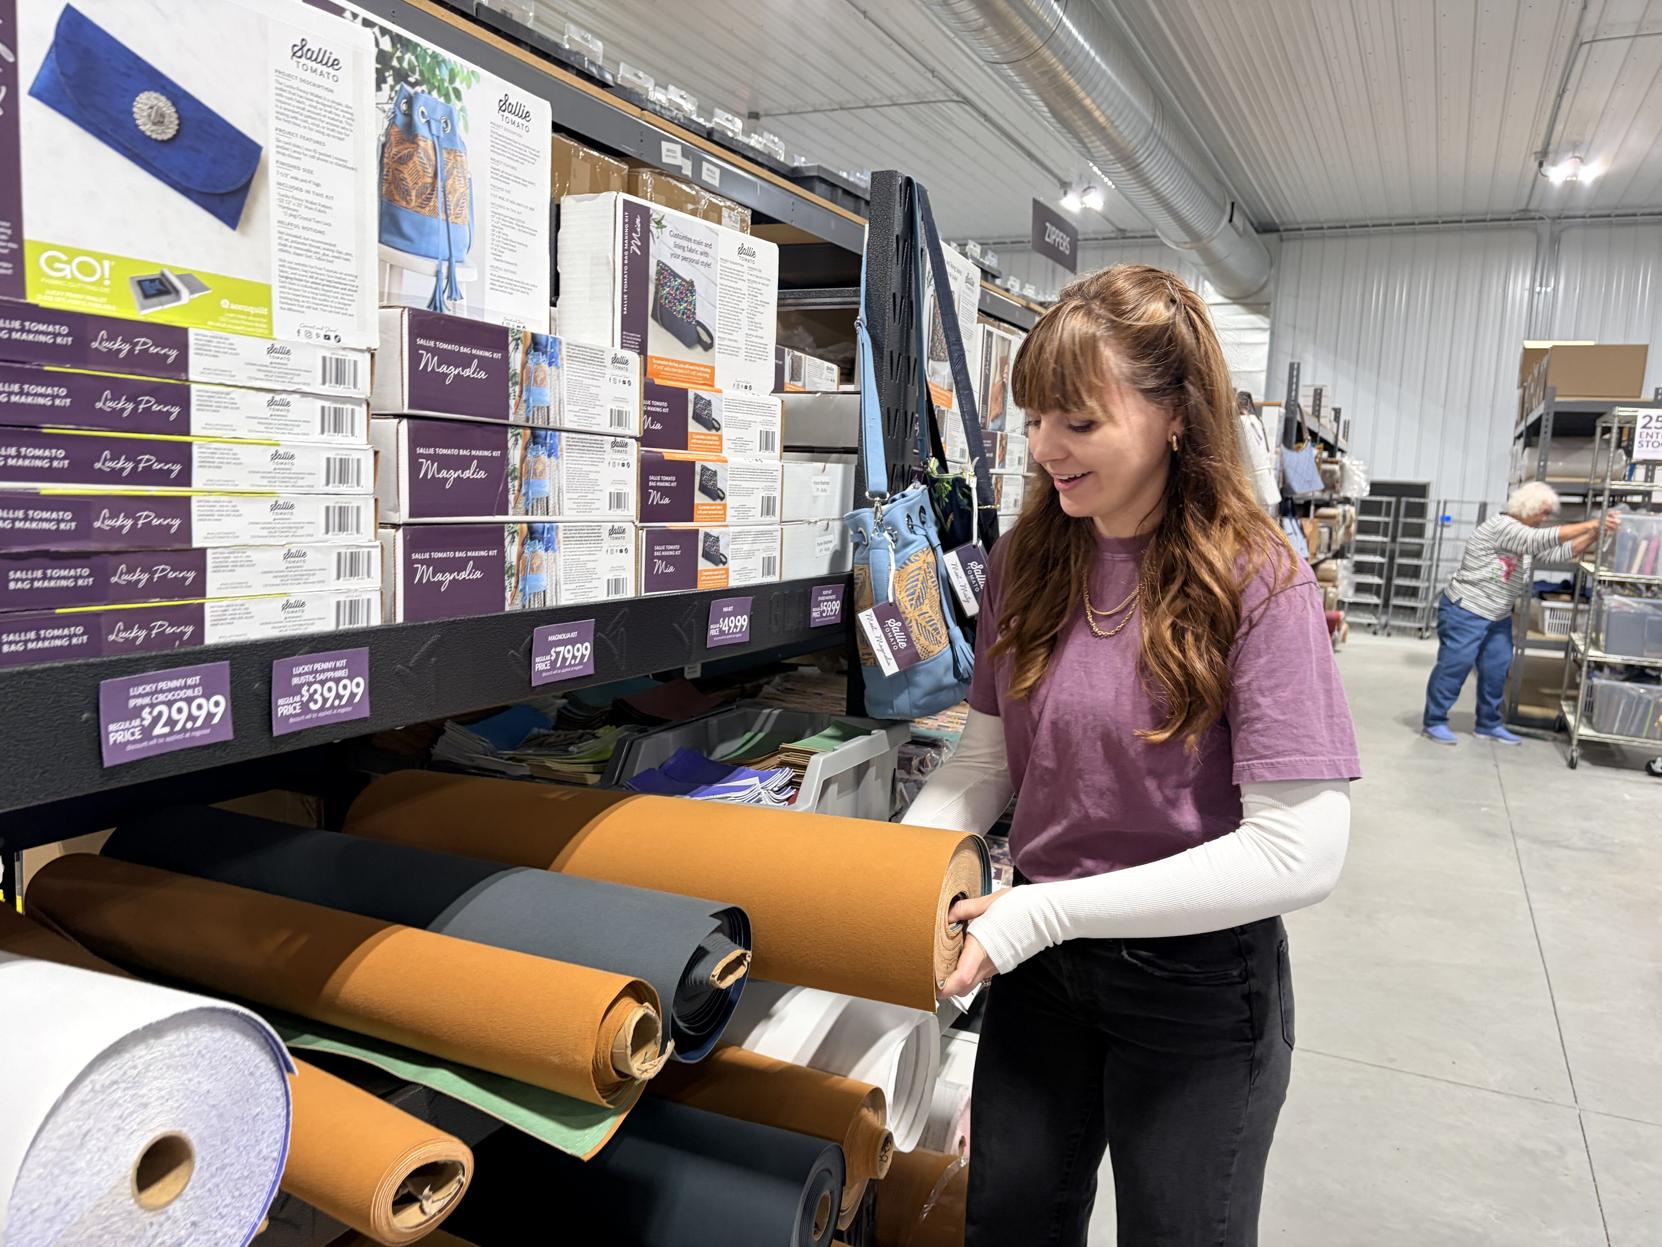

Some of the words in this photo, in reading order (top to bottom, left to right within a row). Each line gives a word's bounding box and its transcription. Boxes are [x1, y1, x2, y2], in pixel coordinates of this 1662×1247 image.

[291, 38, 342, 71] Sallie
[296, 60, 339, 82] TOMATO
[498, 94, 532, 123] Sallie
[501, 114, 530, 133] TOMATO
[630, 215, 641, 255] Mia
[737, 243, 756, 259] Sallie
[39, 250, 111, 286] GO!
[24, 321, 69, 334] TOMATO
[11, 331, 54, 343] MAKING
[56, 337, 73, 346] KIT
[90, 330, 133, 359] Lucky
[133, 338, 179, 364] Penny
[267, 343, 292, 356] Sallie
[416, 338, 435, 347] SALLIE
[436, 342, 459, 352] TOMATO
[460, 346, 471, 354] BAG
[472, 349, 493, 358] MAKING
[611, 353, 630, 366] Sallie
[418, 351, 488, 385] Magnolia
[22, 384, 67, 396] TOMATO
[10, 394, 53, 406] MAKING
[54, 398, 72, 407] KIT
[95, 390, 136, 417] Lucky
[137, 396, 182, 421] Penny
[267, 396, 292, 408] Sallie
[610, 437, 628, 449] Sallie
[1639, 431, 1662, 440] ENT
[1638, 440, 1662, 449] STO
[19, 448, 65, 458] TOMATO
[271, 449, 296, 462] Sallie
[7, 458, 50, 468] MAKING
[52, 460, 70, 468] KIT
[94, 451, 136, 477] Lucky
[136, 455, 183, 479] Penny
[418, 459, 488, 489] Magnolia
[648, 490, 671, 505] Mia
[270, 500, 295, 512] Sallie
[27, 510, 72, 520] TOMATO
[93, 509, 135, 534] Lucky
[135, 511, 182, 534] Penny
[15, 521, 57, 530] MAKING
[59, 522, 77, 530] KIT
[608, 525, 626, 537] Sallie
[283, 549, 307, 561] Sallie
[431, 551, 454, 559] TOMATO
[8, 570, 44, 579] SALLIE
[46, 568, 90, 578] TOMATO
[653, 560, 675, 575] Mia
[8, 581, 31, 590] BAG
[33, 579, 76, 589] MAKING
[77, 578, 95, 586] KIT
[110, 564, 151, 588] Lucky
[152, 565, 197, 585] Penny
[413, 560, 484, 592] Magnolia
[966, 567, 980, 592] TOMATO
[281, 600, 306, 612] Sallie
[820, 600, 840, 617] $59.99
[720, 615, 748, 634] $49.99
[1, 631, 37, 643] SALLIE
[39, 626, 84, 639] TOMATO
[107, 622, 149, 646] Lucky
[149, 621, 195, 641] Penny
[547, 633, 570, 642] MAGNOLIA
[884, 624, 898, 650] TOMATO
[885, 619, 907, 649] Sallie
[1, 642, 25, 654] BAG
[27, 638, 70, 650] MAKING
[71, 635, 89, 645] KIT
[550, 642, 591, 668] $79.99
[292, 664, 313, 675] LUCKY
[313, 662, 336, 671] PENNY
[336, 659, 348, 667] KIT
[535, 661, 551, 672] PRICE
[129, 683, 157, 696] LUCKY
[157, 679, 187, 691] PENNY
[186, 676, 201, 685] KIT
[301, 677, 365, 711] $39.99
[128, 696, 152, 709] (PINK
[152, 686, 203, 703] CROCODILE)
[277, 695, 301, 706] REGULAR
[141, 695, 226, 737] $29.99
[277, 702, 302, 718] PRICE
[108, 718, 141, 732] REGULAR
[108, 727, 143, 746] PRICE
